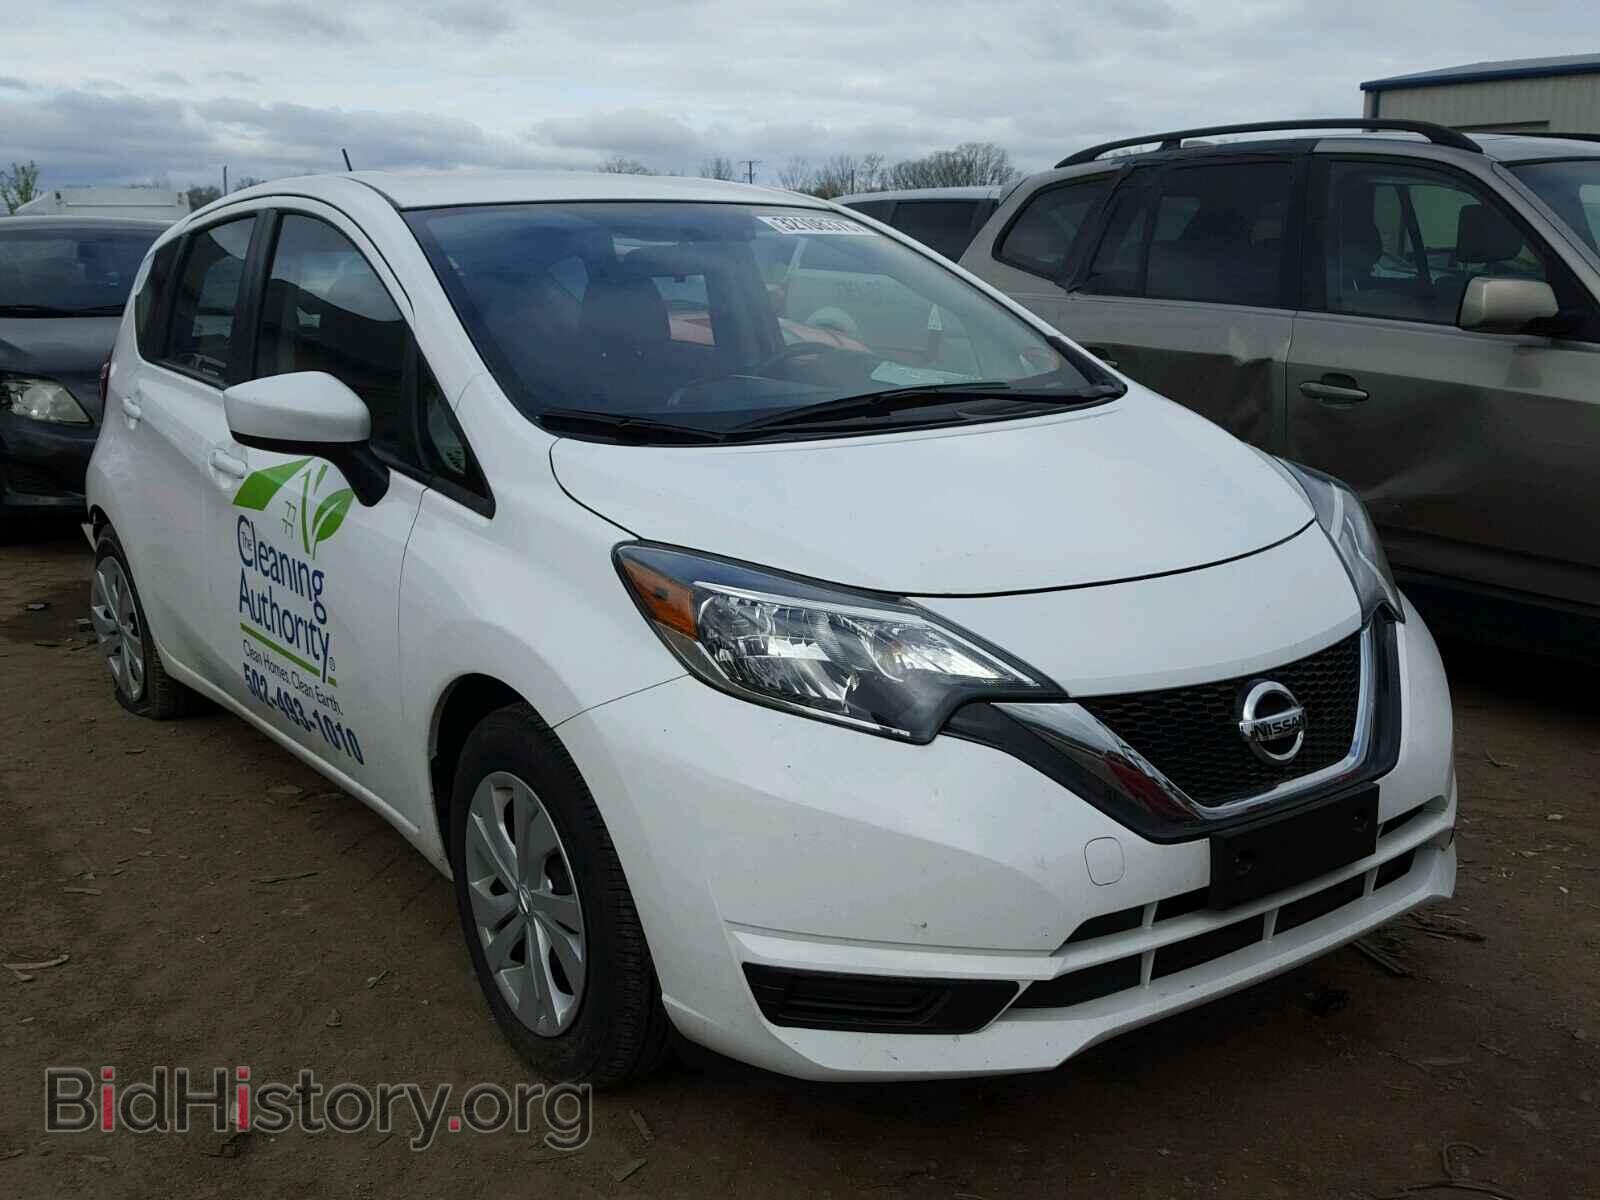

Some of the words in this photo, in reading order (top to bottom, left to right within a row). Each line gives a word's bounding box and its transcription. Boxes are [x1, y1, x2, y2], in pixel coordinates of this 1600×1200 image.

[237, 514, 328, 625] Cleaning
[239, 568, 329, 684] Authority
[243, 639, 264, 666] Clean
[290, 670, 315, 700] Clean
[242, 662, 364, 766] 502-493-1010
